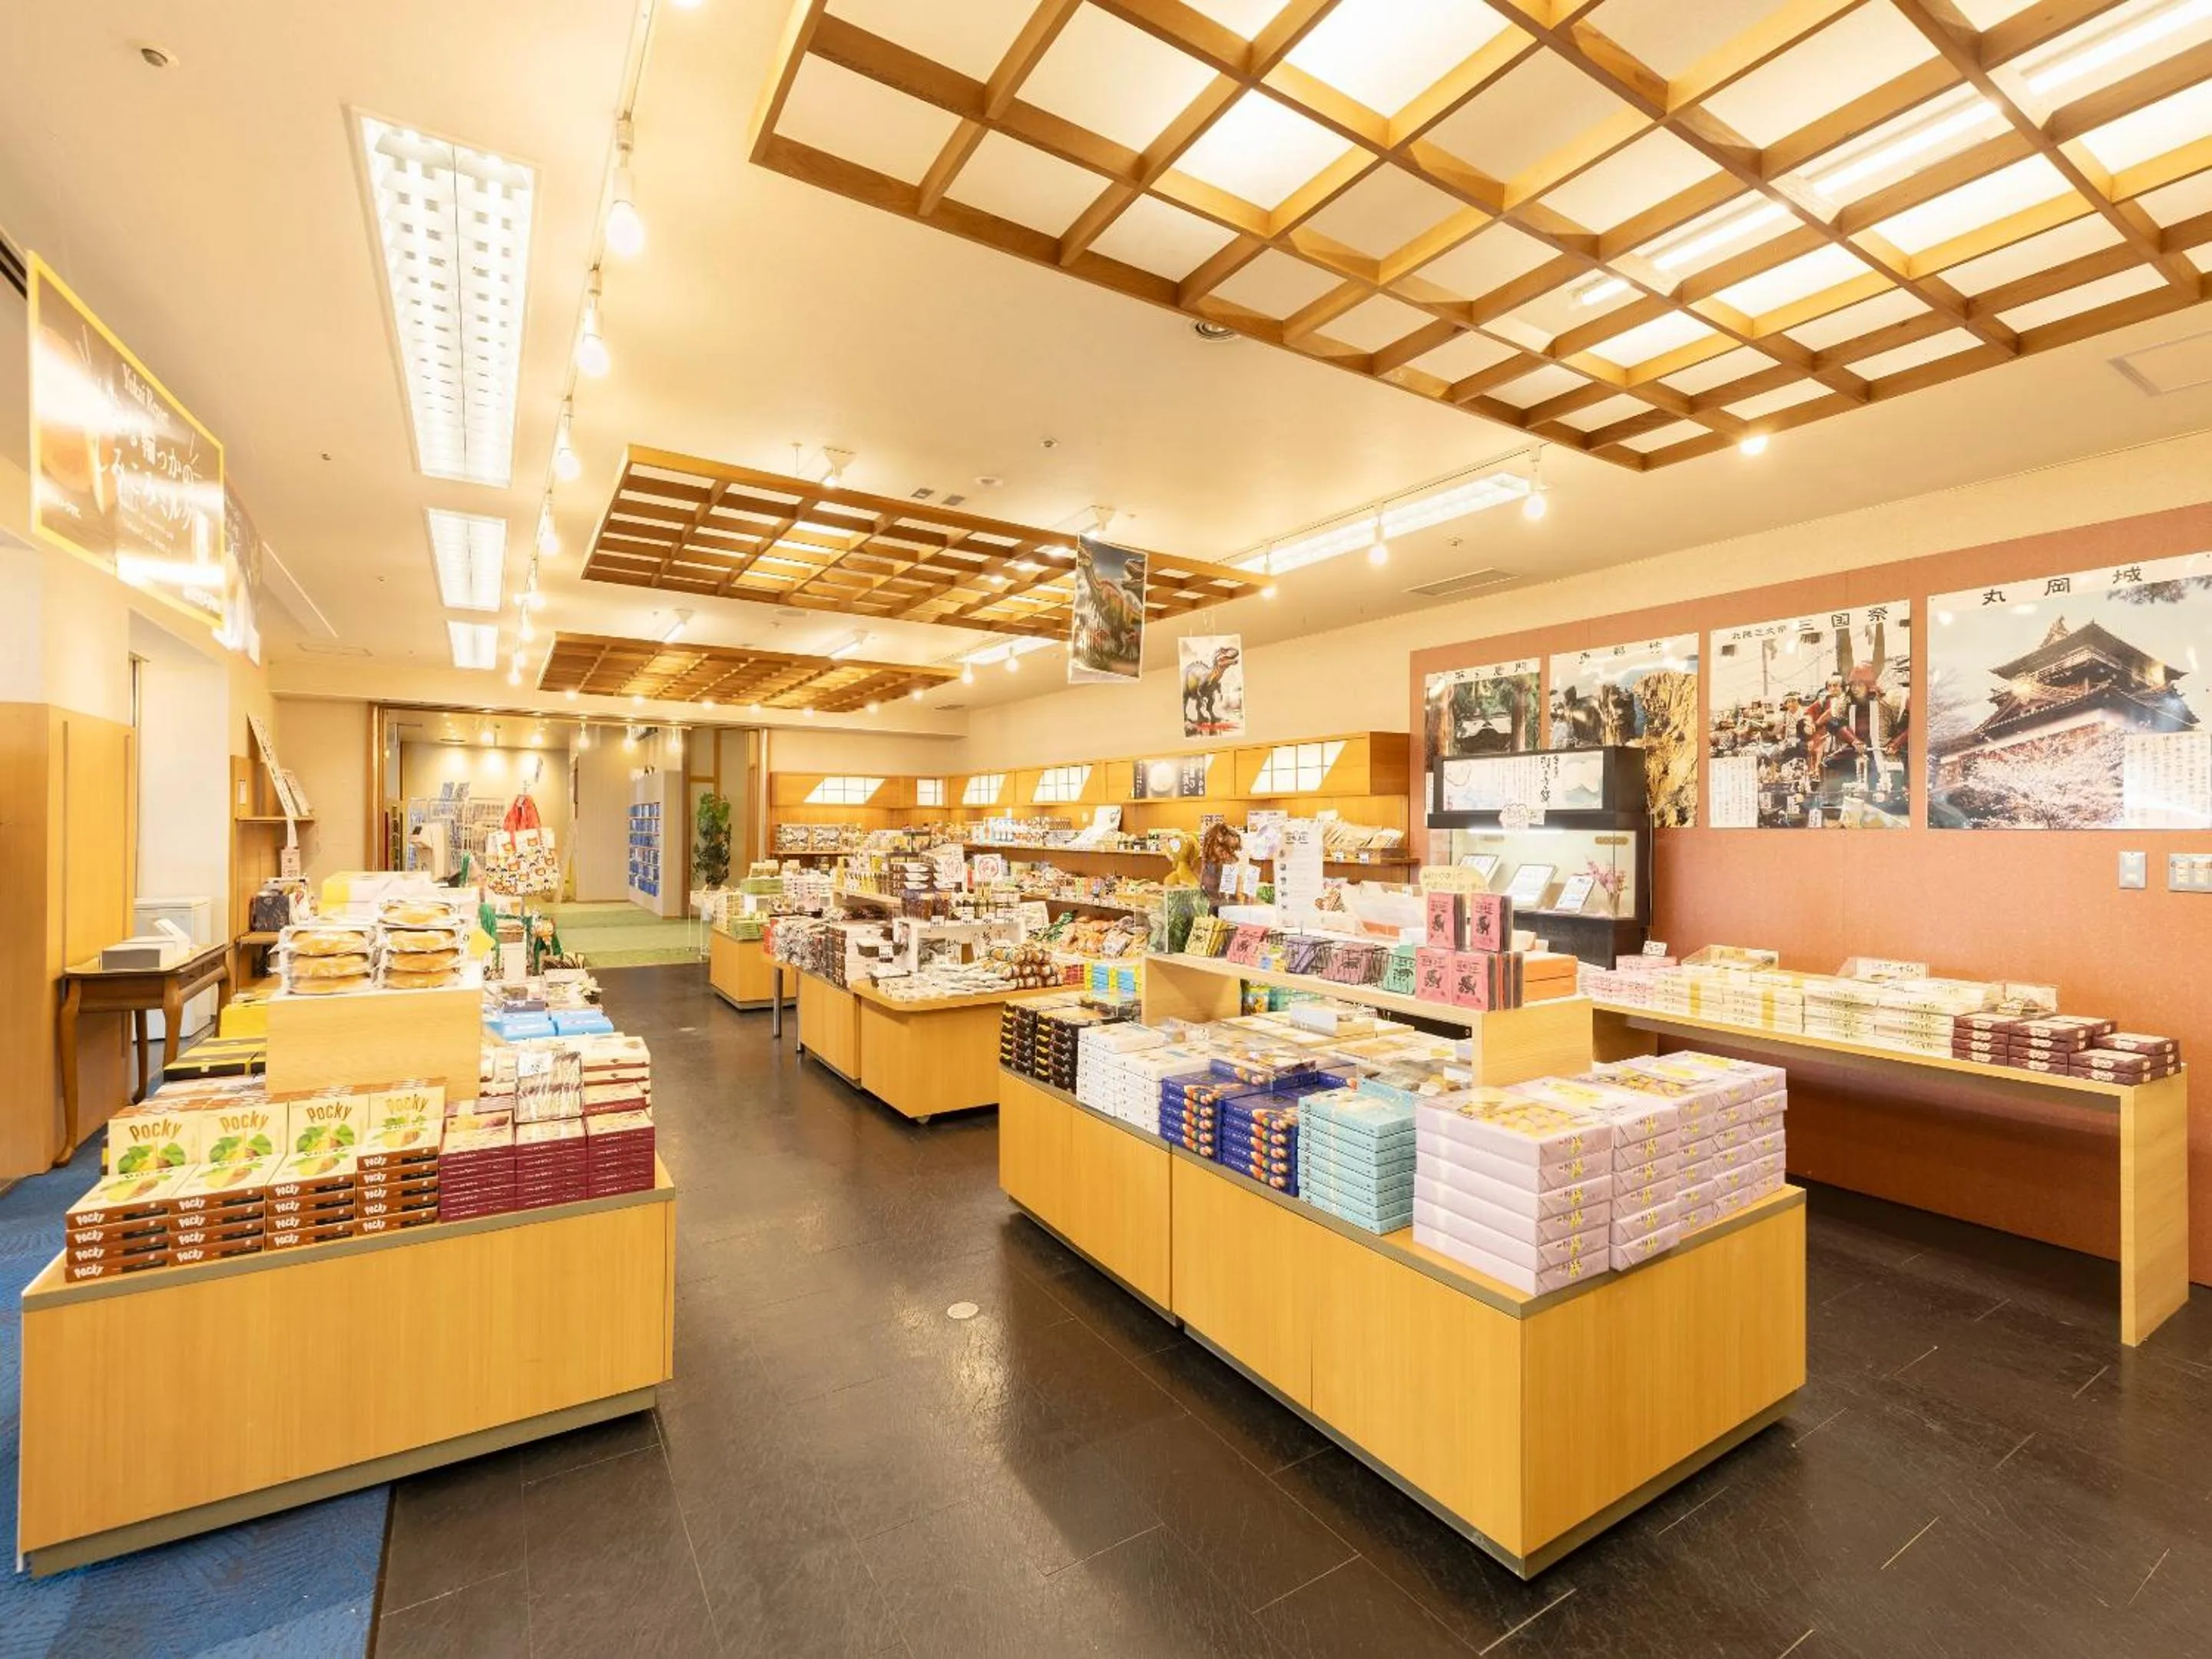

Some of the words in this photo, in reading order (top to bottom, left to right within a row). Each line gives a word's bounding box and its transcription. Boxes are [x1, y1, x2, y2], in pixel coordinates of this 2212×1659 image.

[1981, 565, 2144, 606] 丸岡城
[1797, 605, 1889, 632] 三国祭
[219, 1110, 270, 1134] Pocky
[306, 1101, 353, 1124] Pocky
[128, 1118, 183, 1143] Pocky
